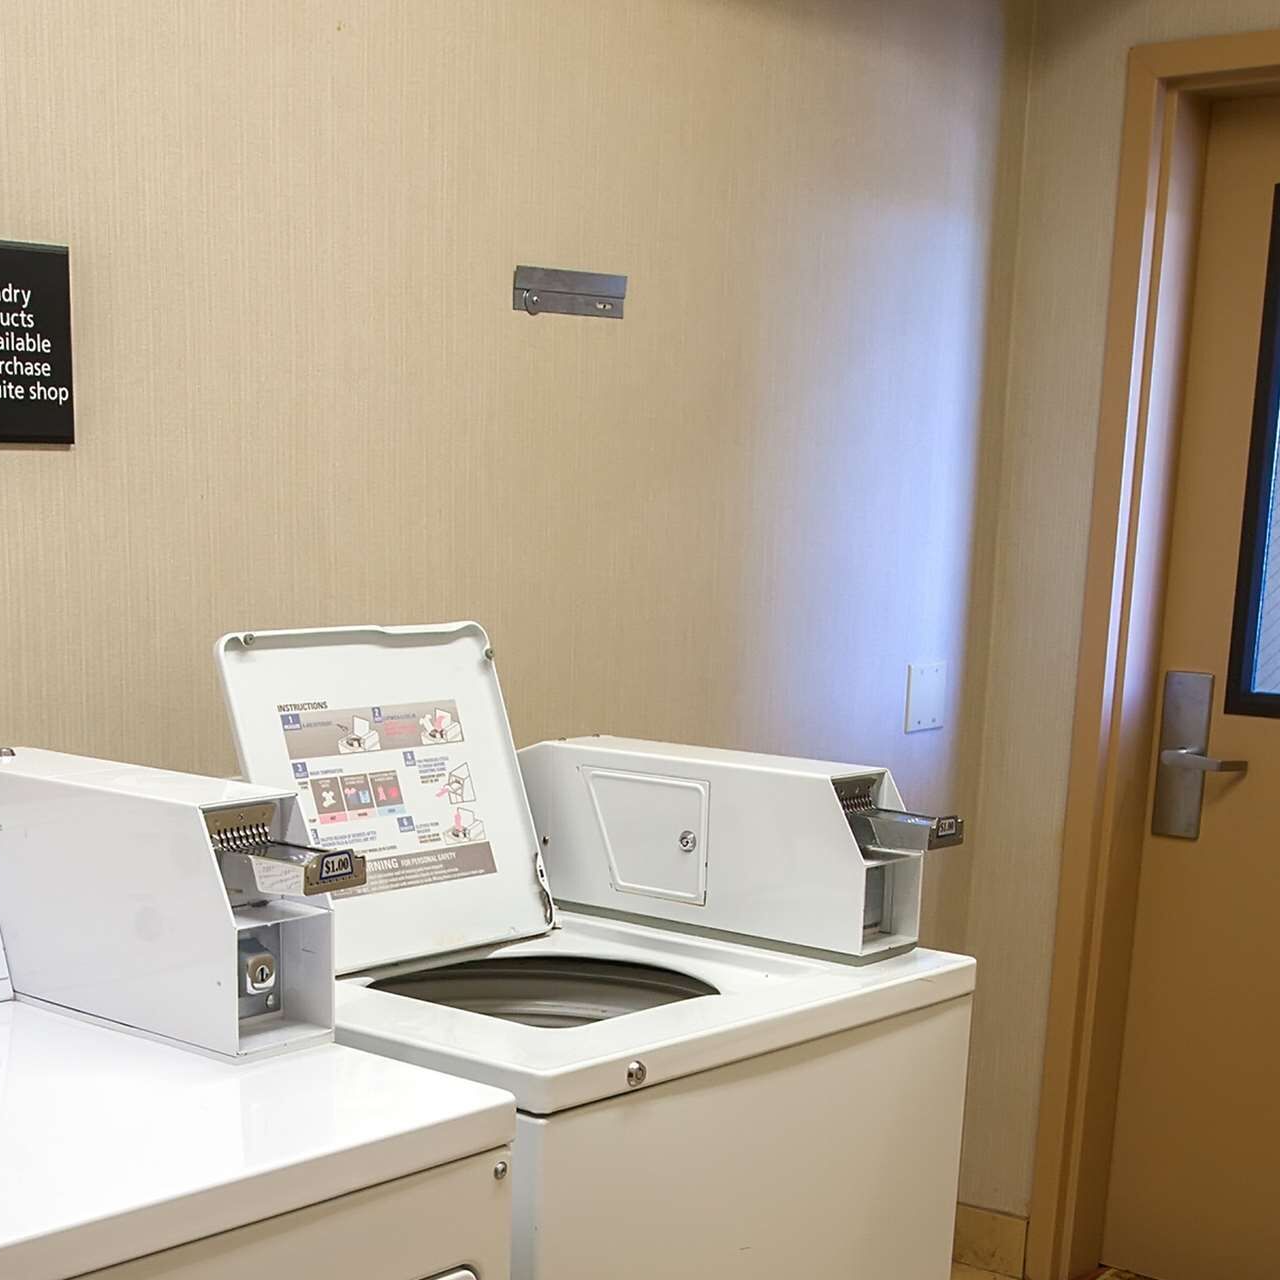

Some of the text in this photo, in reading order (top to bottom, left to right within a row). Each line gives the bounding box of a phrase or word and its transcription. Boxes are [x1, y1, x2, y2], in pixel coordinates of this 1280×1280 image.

[29, 381, 69, 405] shop
[277, 701, 328, 712] INSTRUCTIONS
[324, 857, 349, 874] $1.00
[367, 858, 399, 873] RNING
